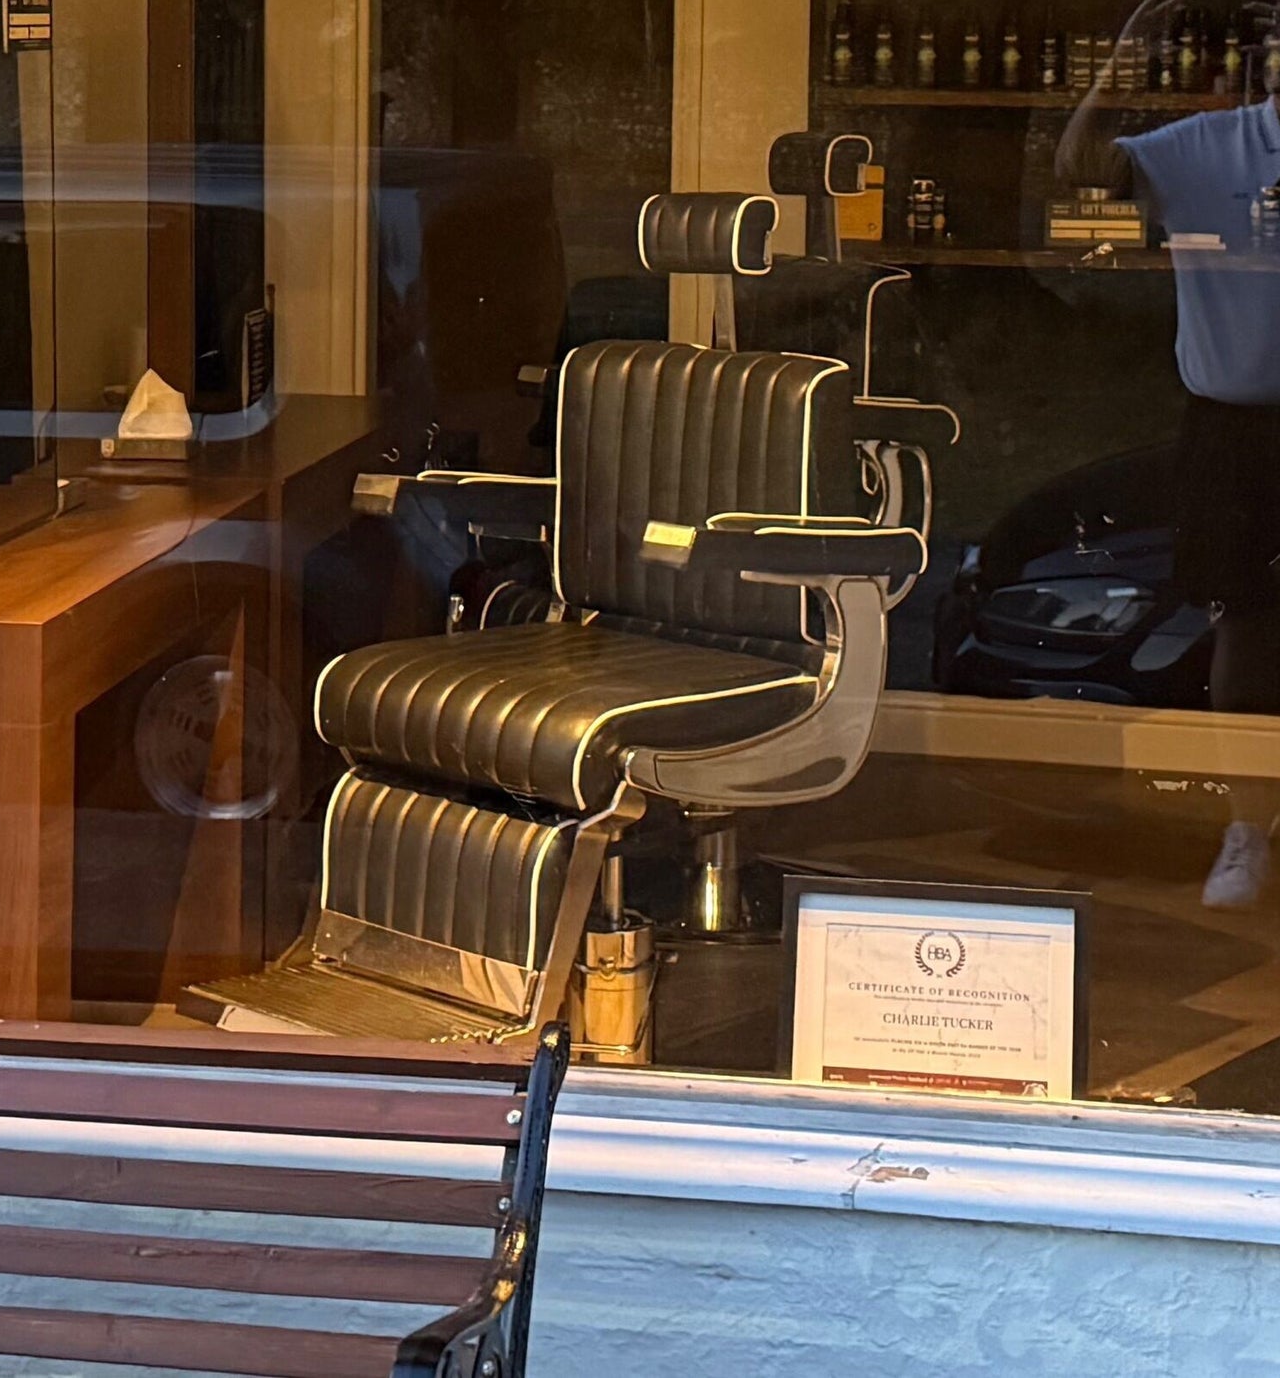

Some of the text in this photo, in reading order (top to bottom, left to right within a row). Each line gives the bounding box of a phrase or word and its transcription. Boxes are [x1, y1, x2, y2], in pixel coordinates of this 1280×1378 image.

[927, 944, 953, 962] HBA
[848, 981, 925, 995] CERTIFICATE
[928, 986, 944, 997] OF
[948, 988, 1031, 1003] RECOGNITION
[882, 1012, 994, 1032] CHARLIE TUCKER
